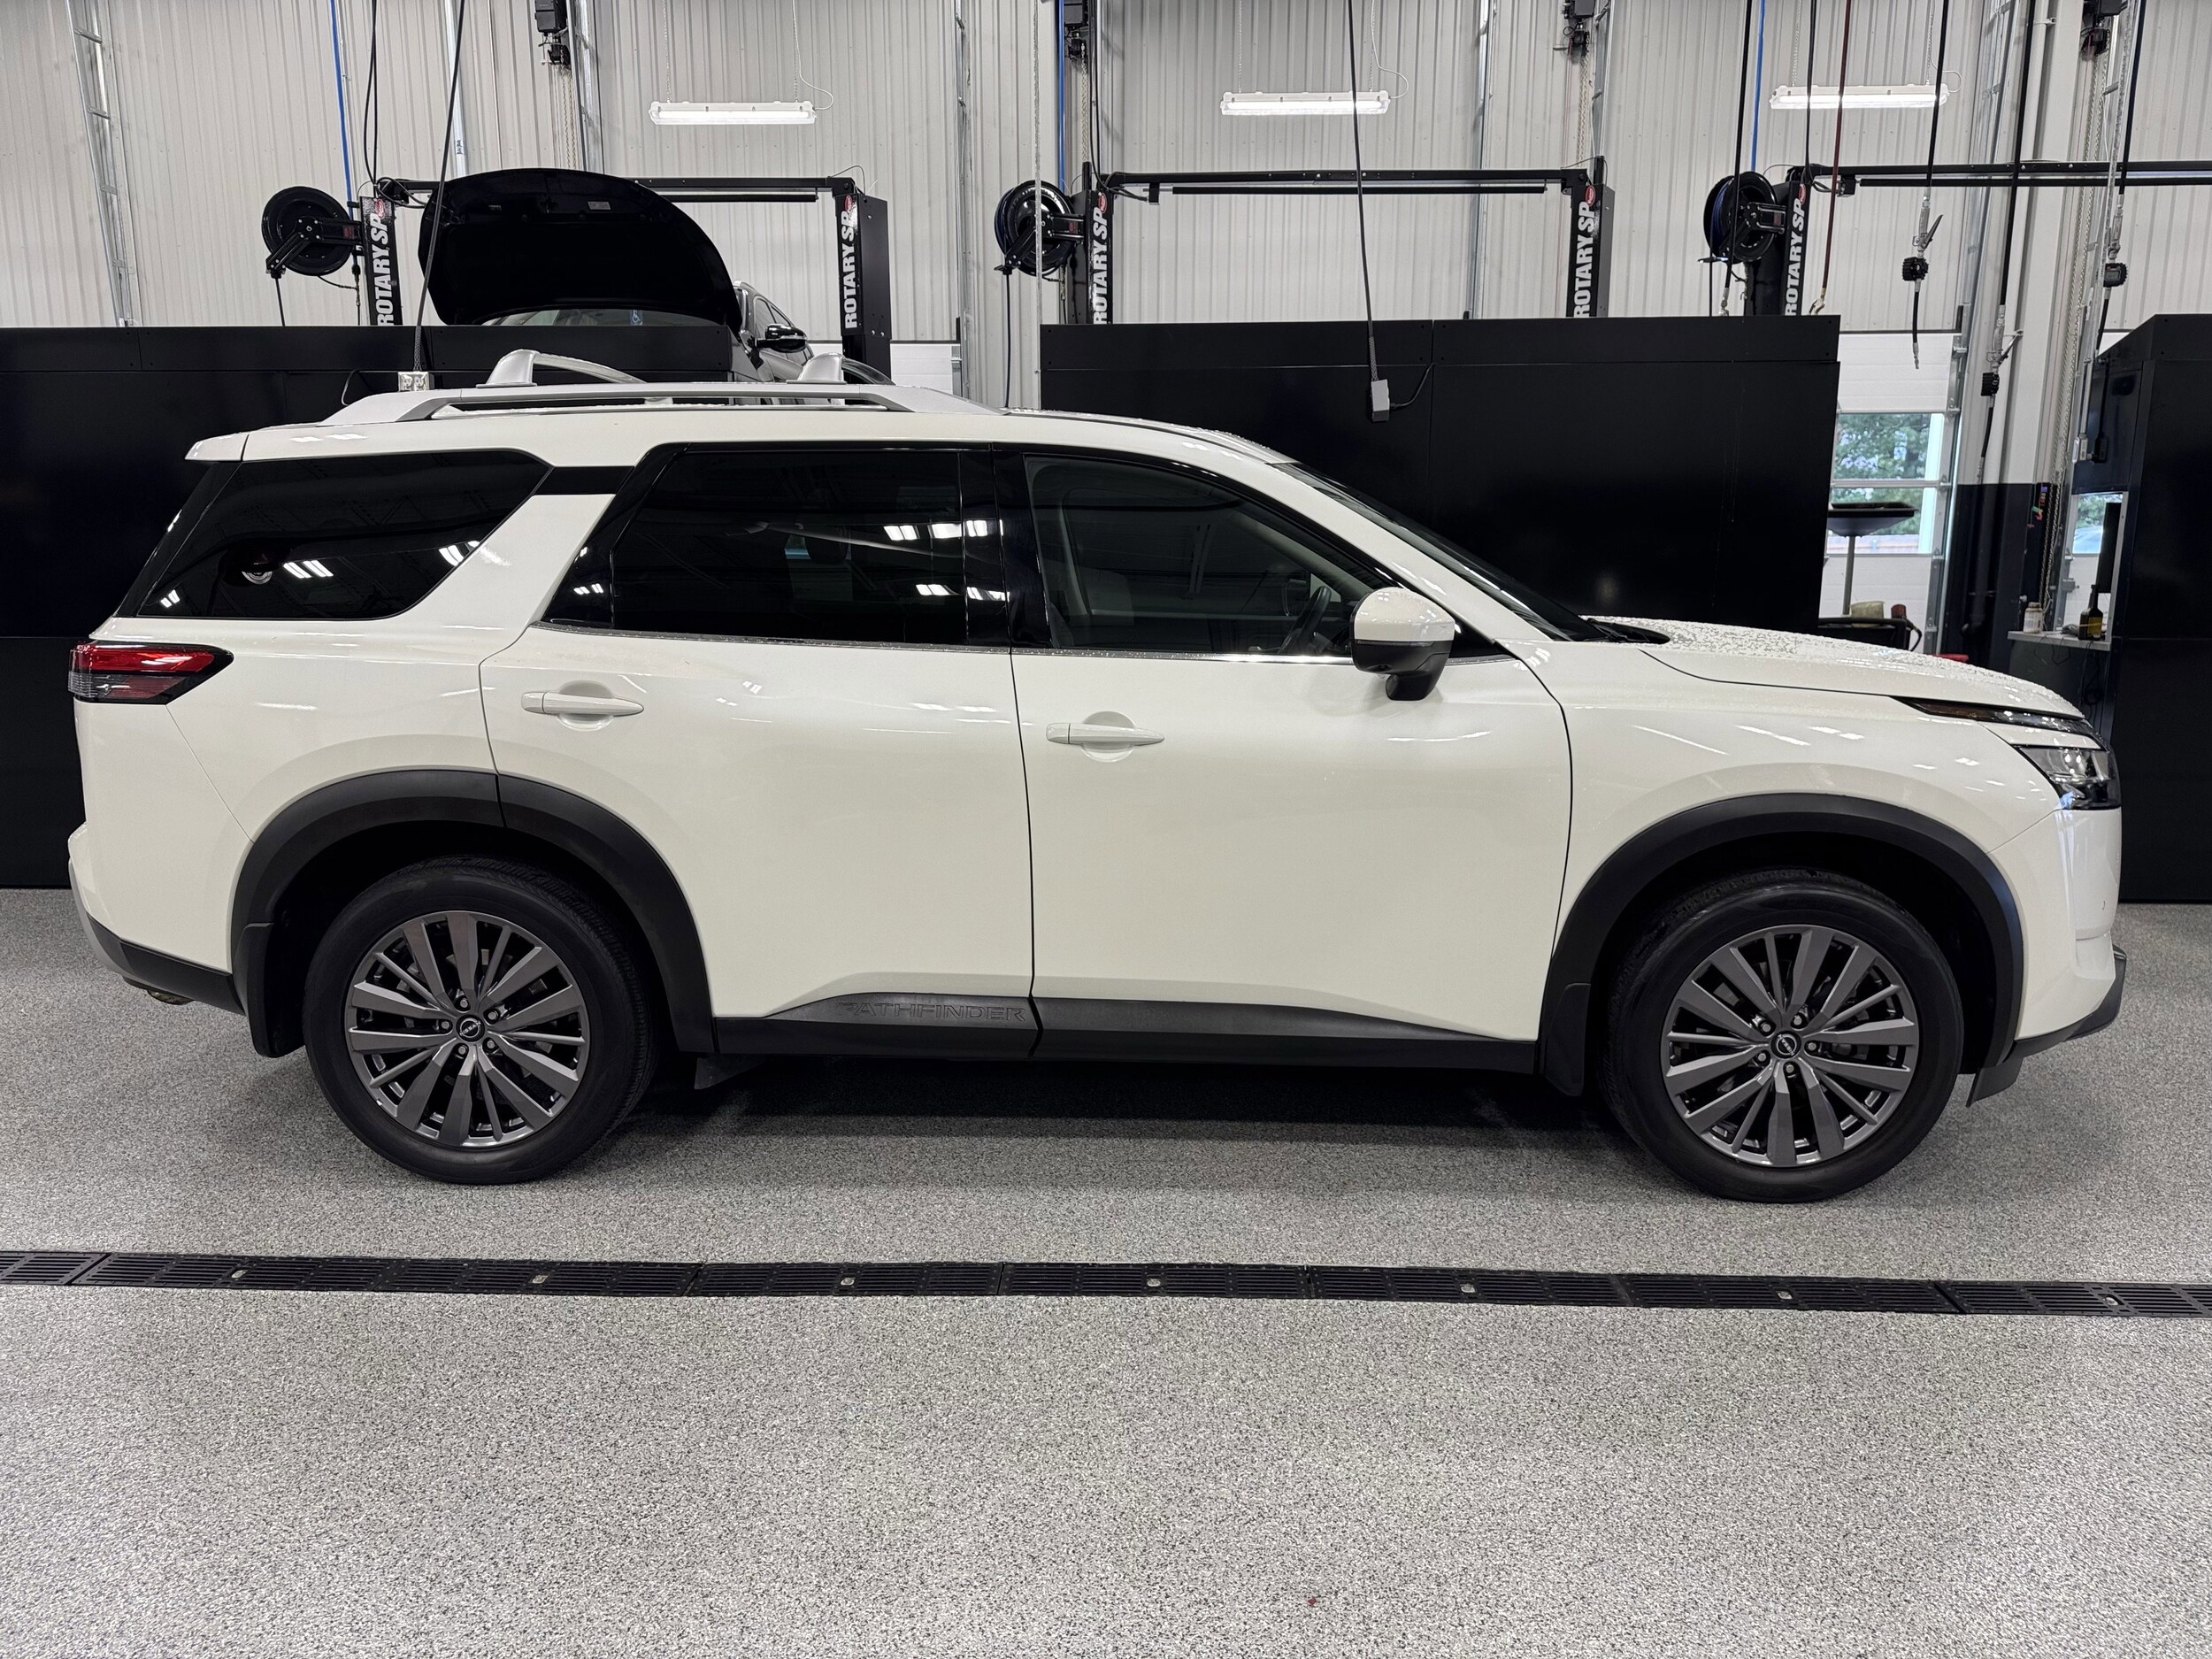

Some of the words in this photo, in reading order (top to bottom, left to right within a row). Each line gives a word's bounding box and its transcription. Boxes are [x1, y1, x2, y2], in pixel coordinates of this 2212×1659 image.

[370, 213, 388, 244] SP
[841, 211, 856, 241] SP
[1093, 207, 1107, 240] SP
[1578, 201, 1594, 233] SP
[1792, 198, 1805, 232] SP
[372, 244, 394, 326] ROTARY
[842, 243, 857, 328] ROTARY
[1093, 240, 1107, 324] ROTARY
[1573, 234, 1593, 317] ROTARY
[1785, 231, 1802, 316] ROTARY
[835, 1002, 1027, 1022] PATHFINDER
